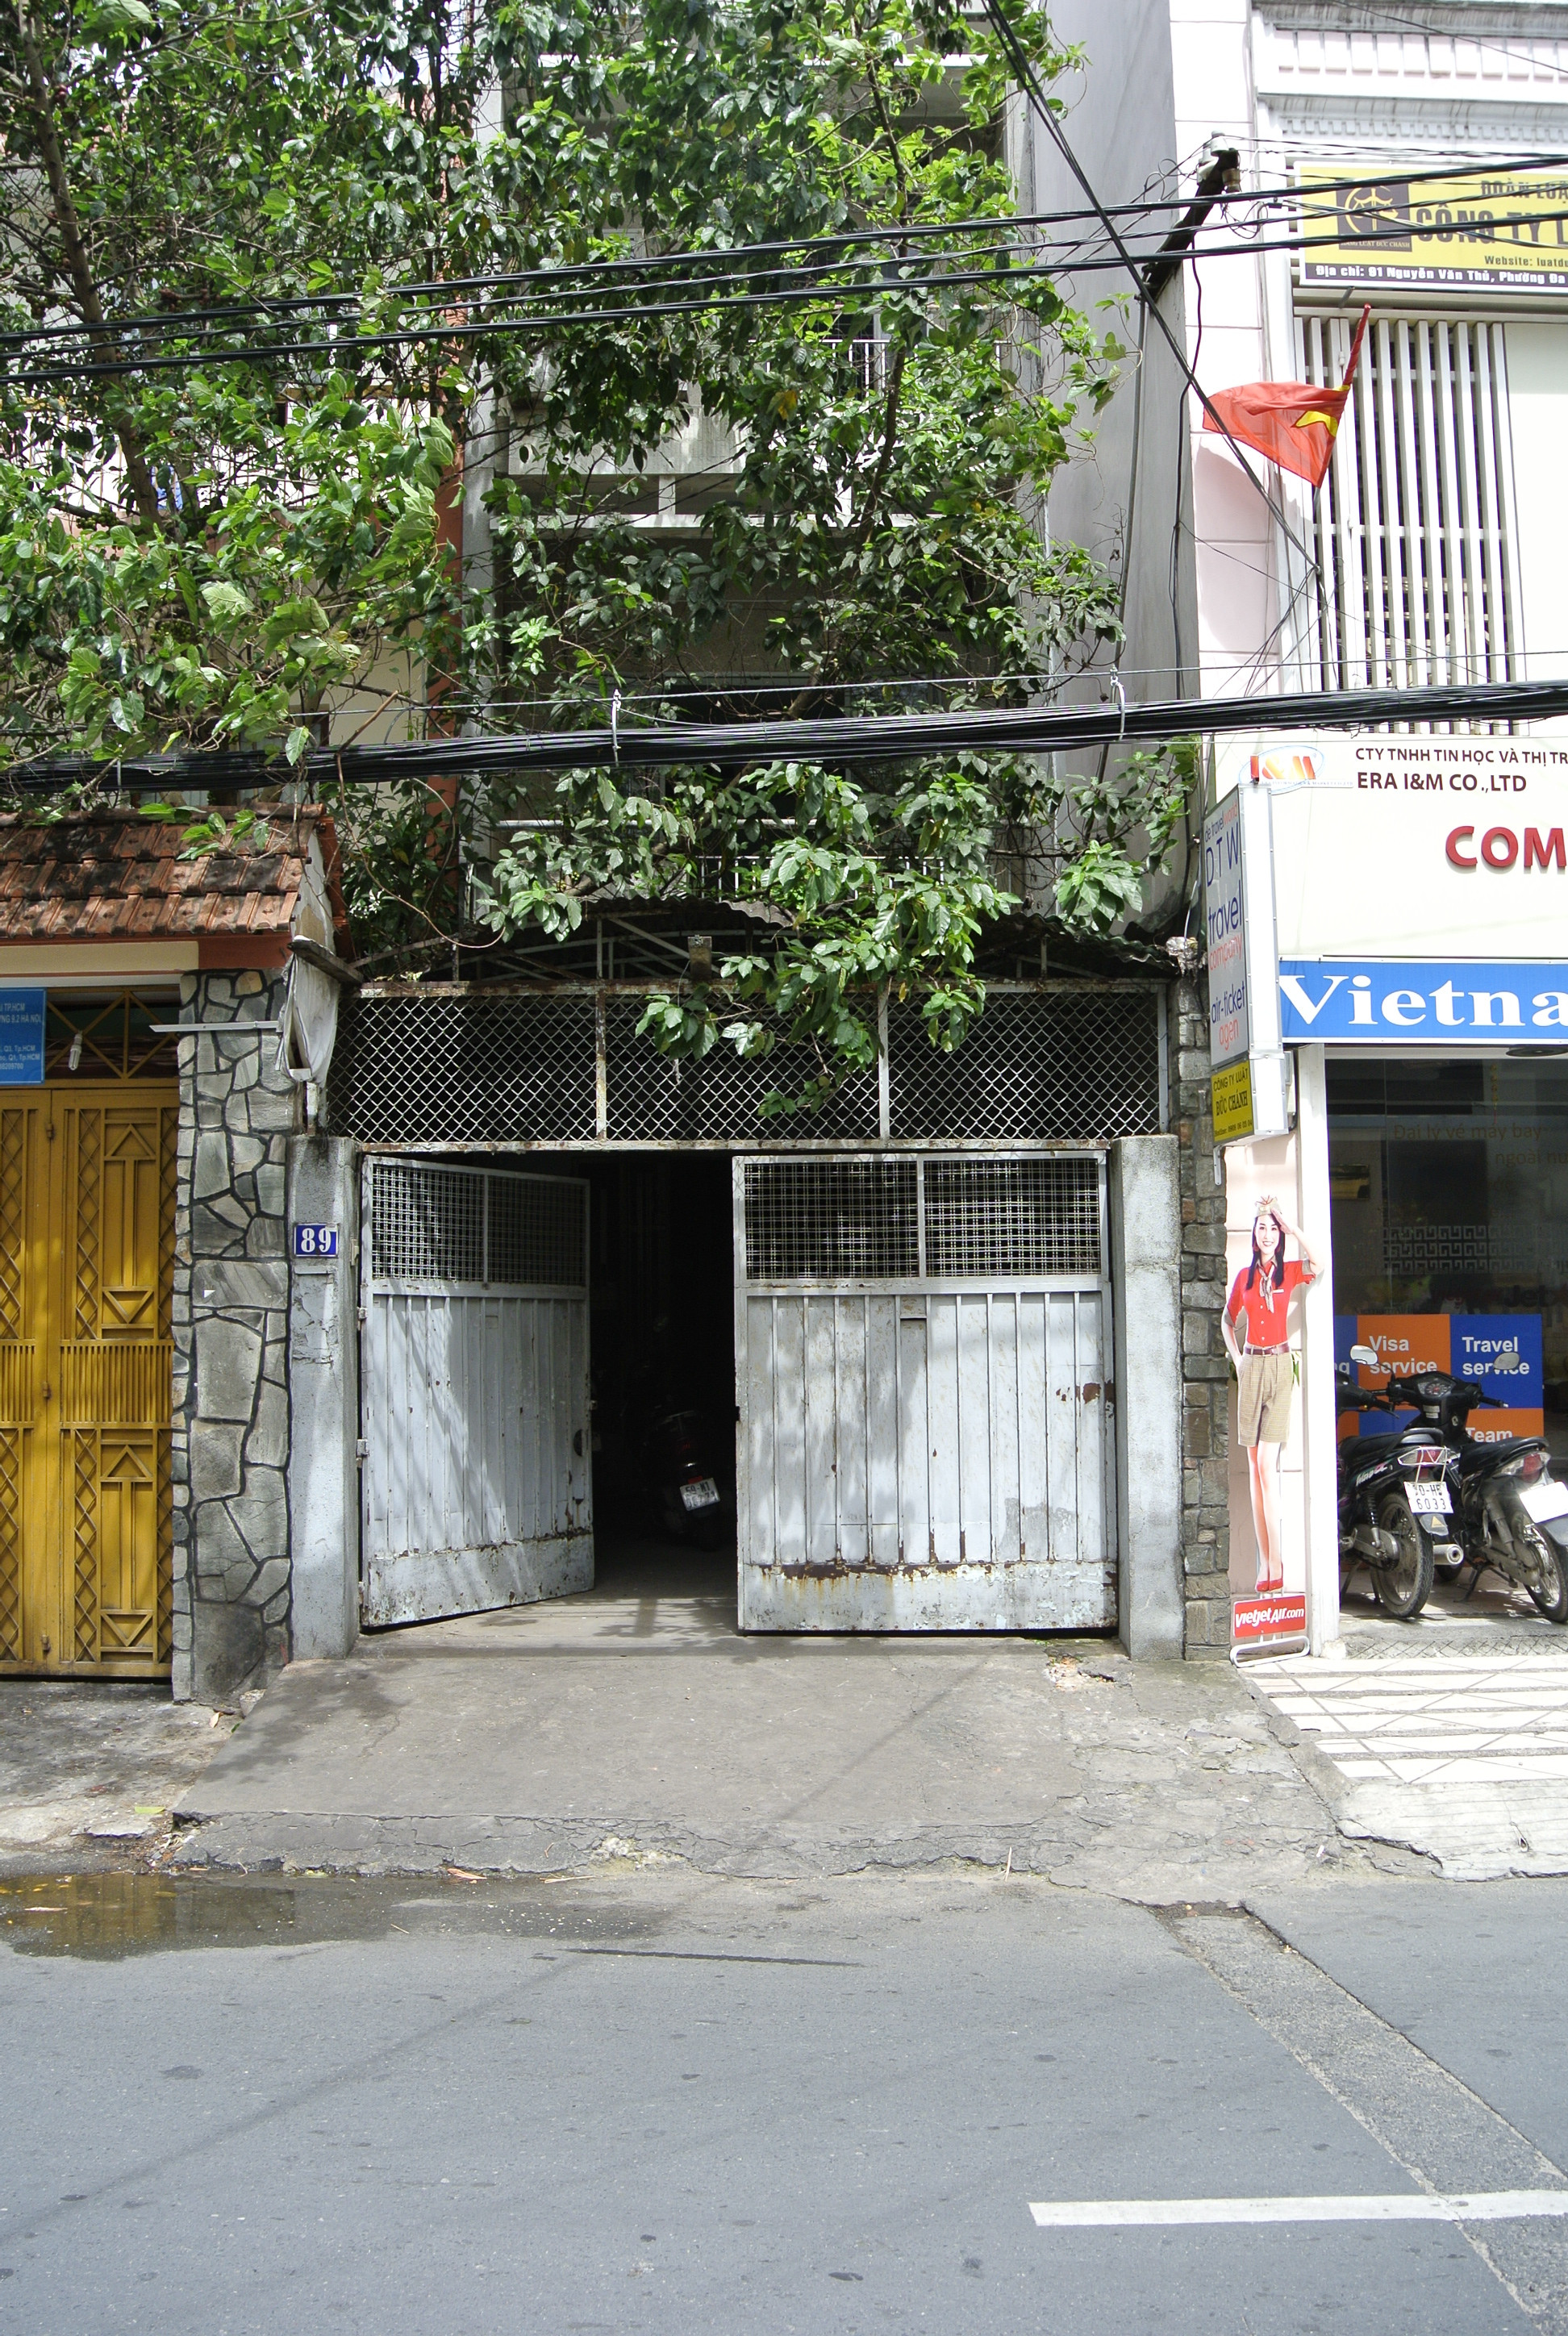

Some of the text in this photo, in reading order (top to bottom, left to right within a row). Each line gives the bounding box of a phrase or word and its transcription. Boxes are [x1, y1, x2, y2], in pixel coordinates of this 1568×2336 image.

[1416, 203, 1494, 244] CÔNG
[1485, 255, 1533, 266] Website:
[1316, 265, 1337, 277] Địa
[1341, 265, 1364, 277] chỉ:
[1368, 266, 1382, 277] 91
[1438, 269, 1462, 281] Văn
[1549, 273, 1566, 284] Đa
[1356, 748, 1384, 761] CTY
[1387, 749, 1430, 761] TNHH
[1433, 749, 1458, 761] TIN
[1462, 750, 1495, 765] HỌC
[1499, 748, 1519, 763] VÀ
[1522, 751, 1546, 766] THỊ
[1357, 772, 1398, 790] ERA
[1403, 773, 1444, 790] I&M
[1445, 825, 1567, 868] COM
[1208, 879, 1242, 946] travel
[1278, 974, 1568, 1027] Vietna
[301, 1228, 332, 1253] 89
[1369, 1336, 1409, 1352] Visa
[1462, 1336, 1518, 1353] Travel
[1416, 1498, 1446, 1509] 6033
